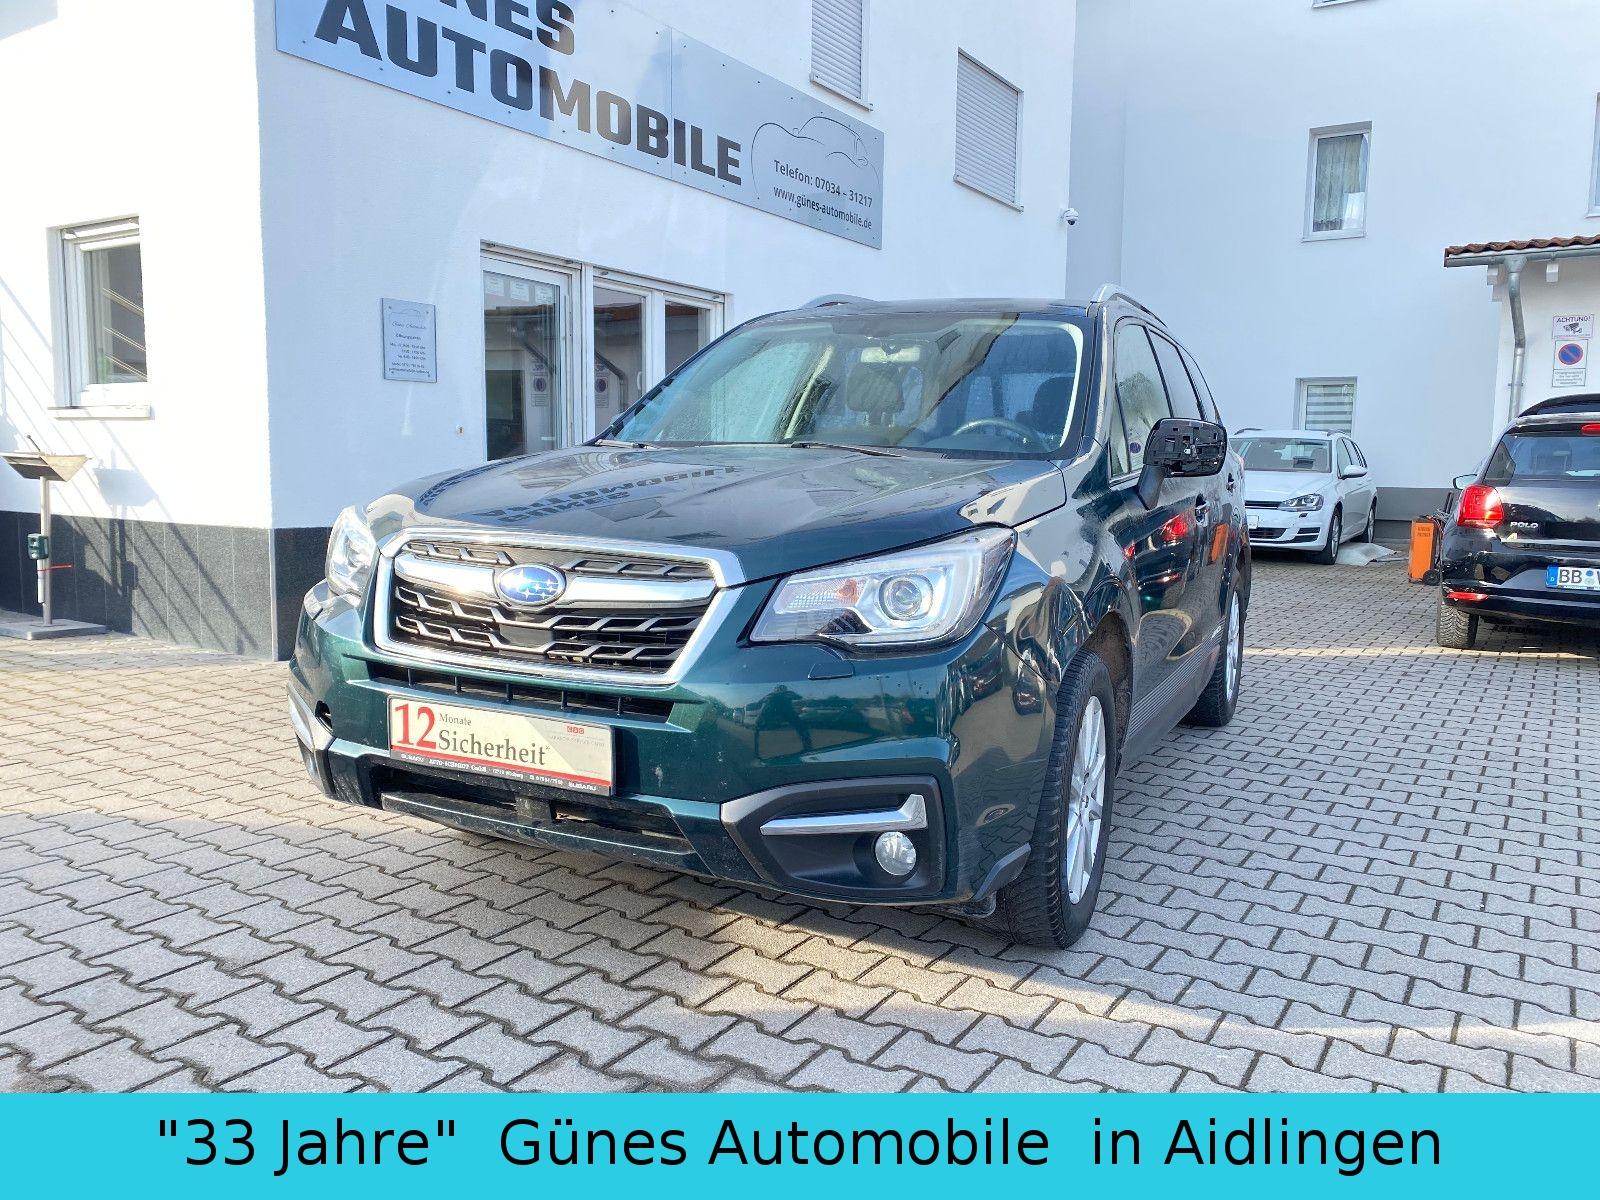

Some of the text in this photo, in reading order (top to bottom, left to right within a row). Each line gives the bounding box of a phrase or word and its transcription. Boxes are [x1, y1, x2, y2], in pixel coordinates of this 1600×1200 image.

[314, 0, 742, 186] AUTOMOBILE
[773, 159, 813, 186] Telefon:
[815, 176, 841, 196] 07034
[849, 189, 873, 208] 31217
[773, 186, 873, 230] www.günes-automobile.de
[1556, 315, 1591, 323] ACHTUNG!
[1510, 521, 1539, 529] POLO
[1558, 569, 1583, 584] BB
[394, 703, 437, 750] 12
[439, 712, 473, 727] Monate
